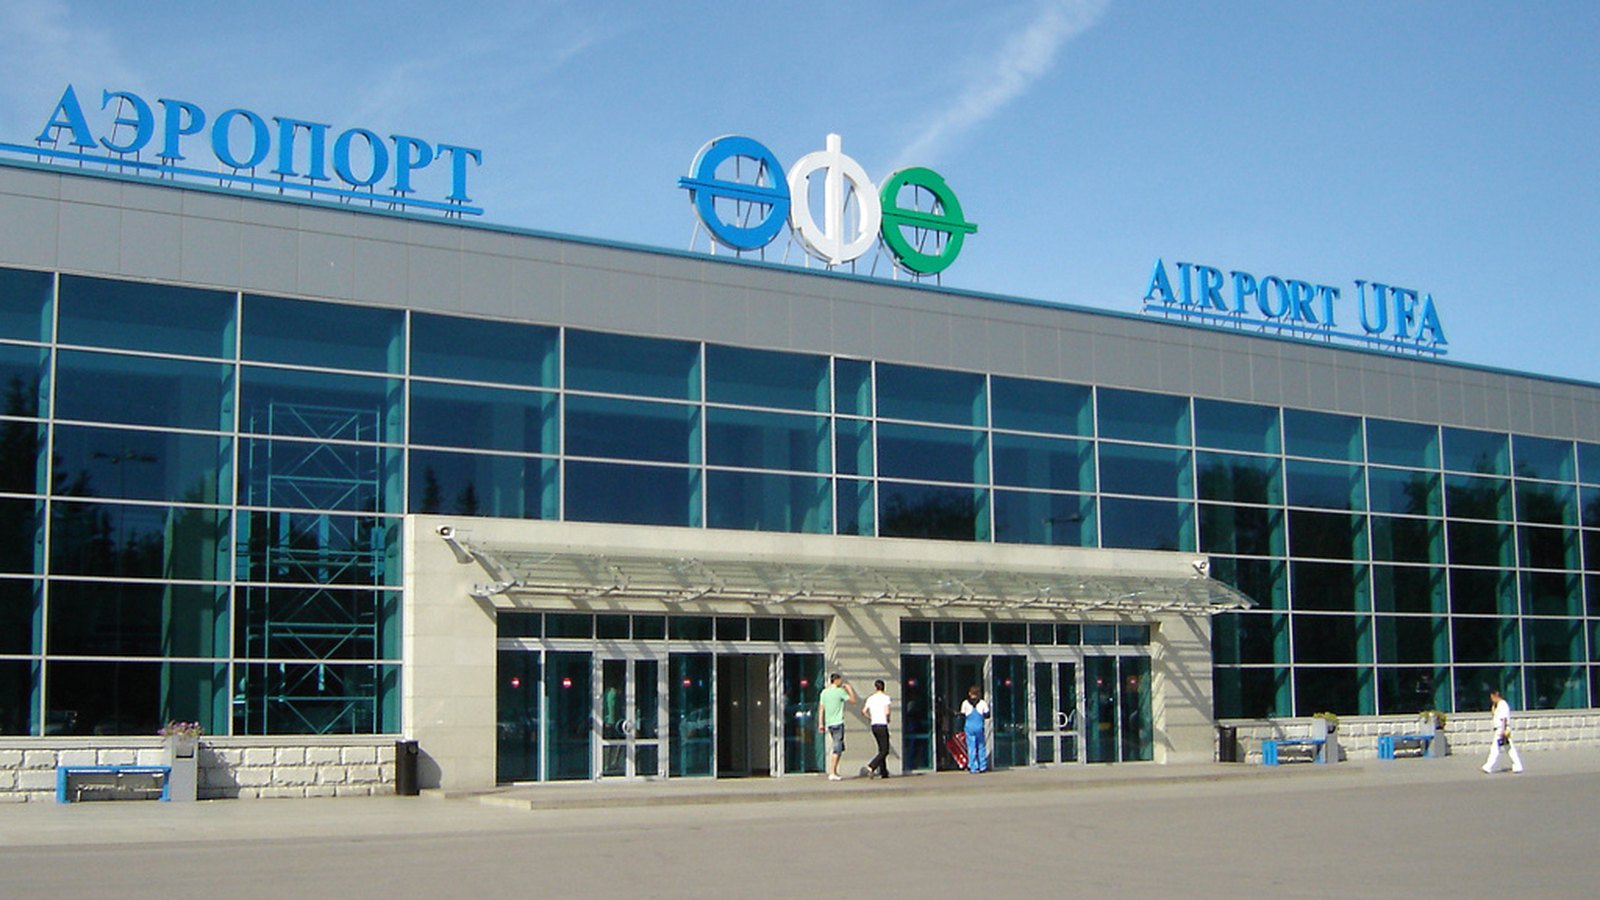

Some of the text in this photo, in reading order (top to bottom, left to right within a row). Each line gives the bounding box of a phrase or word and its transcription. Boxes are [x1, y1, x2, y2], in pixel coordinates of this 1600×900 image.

[35, 84, 482, 202] АЭРОПОРТ
[1144, 257, 1448, 345] AIRPORT UFA
